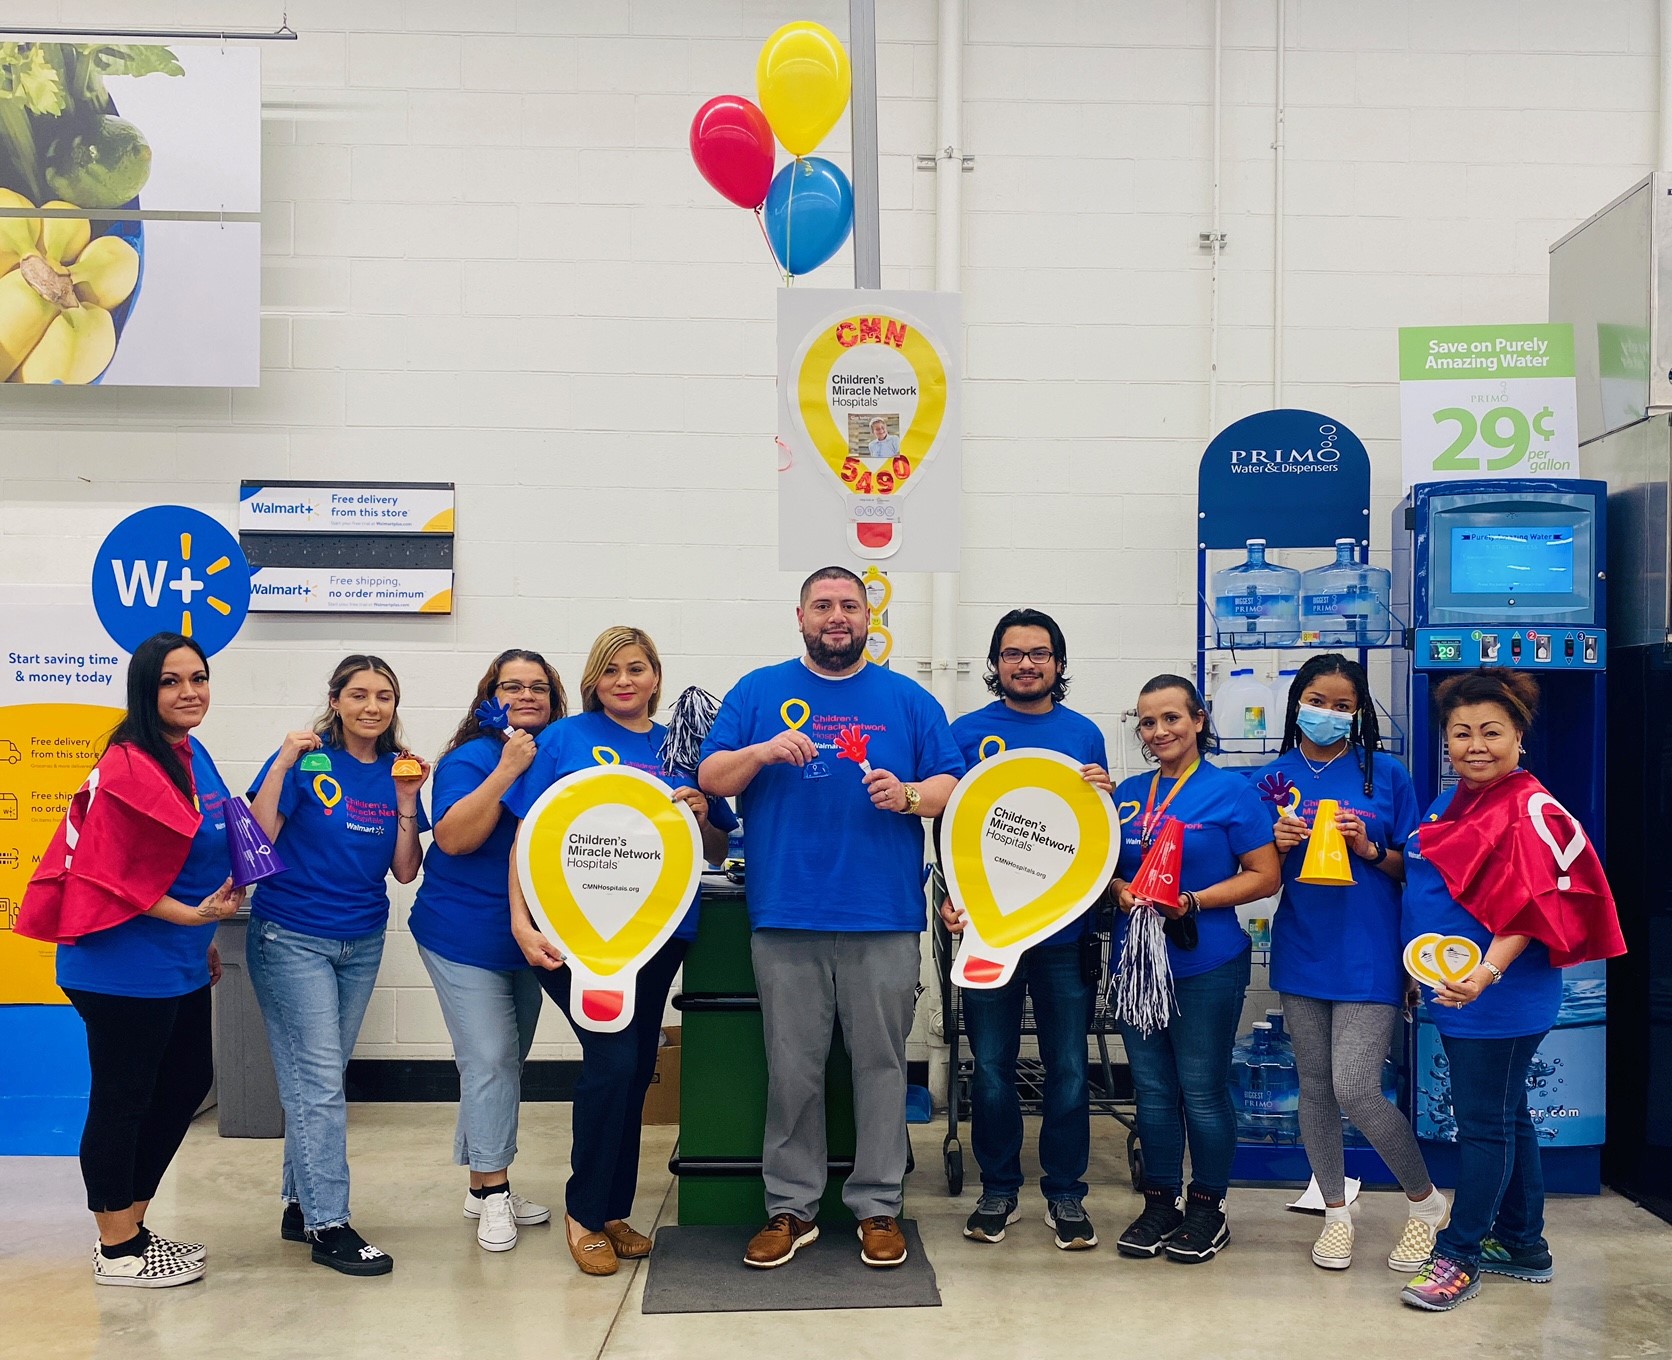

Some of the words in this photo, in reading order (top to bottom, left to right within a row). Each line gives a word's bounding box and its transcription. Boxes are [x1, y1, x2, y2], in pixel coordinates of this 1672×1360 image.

[836, 318, 908, 349] CMN
[1429, 339, 1467, 354] Save
[1470, 341, 1491, 353] on
[1495, 337, 1548, 354] Purely
[1425, 355, 1497, 371] Amazing
[1500, 354, 1550, 367] Water
[832, 375, 884, 385] Children's
[832, 386, 871, 396] Miracle
[873, 386, 917, 396] Network
[832, 397, 878, 408] Hospitals
[1471, 394, 1509, 403] PRIMO
[1230, 448, 1340, 463] PRIMO
[1528, 451, 1550, 462] per
[1530, 459, 1570, 473] gallon
[840, 455, 911, 494] 5490
[331, 494, 354, 504] Free
[357, 495, 398, 506] delivery
[331, 507, 356, 517] from
[360, 508, 379, 517] this
[381, 508, 408, 517] store
[111, 559, 204, 607] W+
[329, 576, 353, 585] Free
[356, 576, 401, 588] shipping,
[329, 590, 342, 598] no
[345, 589, 373, 598] order
[376, 589, 424, 599] minimum
[9, 652, 40, 664] Start
[44, 653, 85, 667] saving
[89, 653, 119, 664] time
[15, 670, 25, 682] &
[29, 673, 72, 685] money
[75, 672, 112, 685] today
[812, 723, 846, 731] Miracle
[31, 737, 52, 745] Free
[54, 737, 91, 748] delivery
[31, 750, 54, 758] from
[56, 750, 73, 758] this
[75, 751, 100, 759] store
[31, 791, 52, 799] Free
[55, 792, 73, 802] ship
[46, 804, 67, 812] orde
[994, 807, 1047, 832] Children's
[346, 822, 375, 834] Walmart
[569, 833, 627, 847] Children's
[986, 828, 1032, 851] Hospitals
[989, 817, 1029, 838] Miracle
[1031, 831, 1075, 854] Network
[568, 845, 611, 858] Miracle
[614, 848, 661, 861] Network
[567, 857, 618, 870] Hospitals
[994, 856, 1047, 879] CMNHospitals.org
[582, 883, 640, 893] CMNHospitals.org
